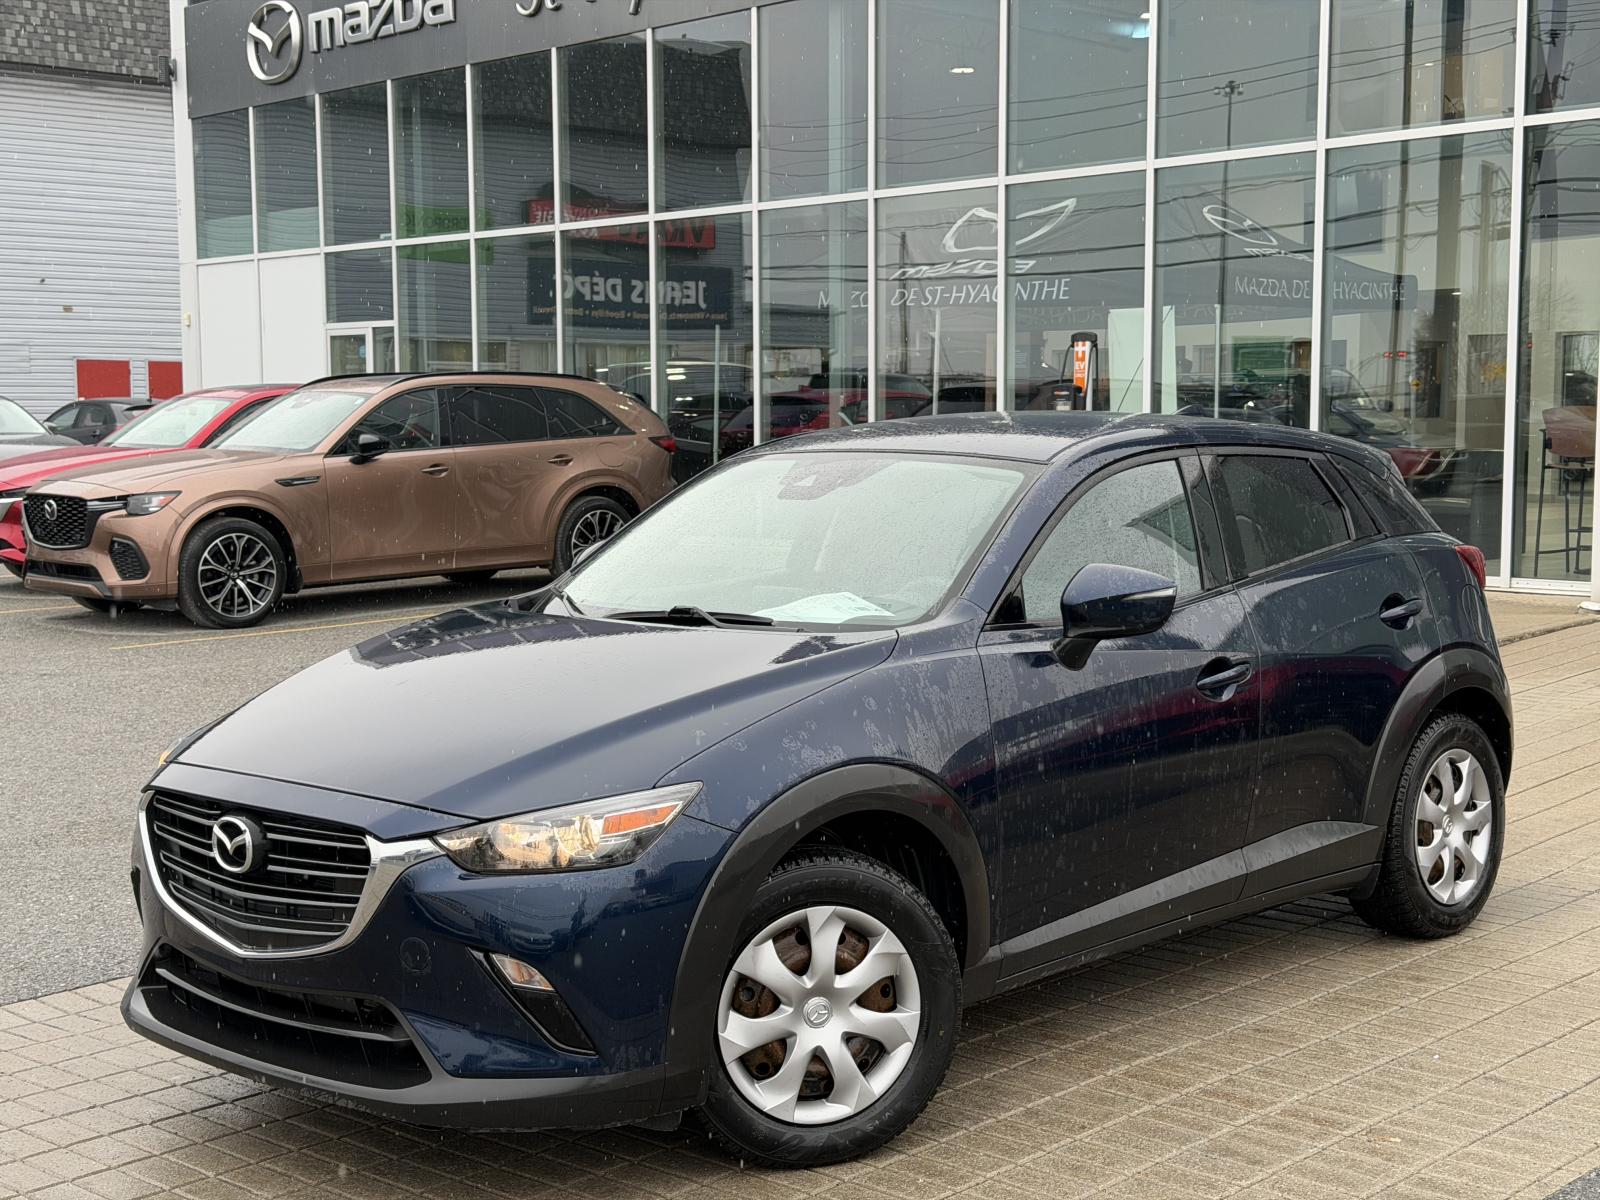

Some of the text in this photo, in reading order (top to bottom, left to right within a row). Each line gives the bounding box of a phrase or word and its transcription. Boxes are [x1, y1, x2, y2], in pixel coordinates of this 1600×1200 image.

[890, 287, 919, 306] DE
[920, 278, 1071, 306] ST-HYACNTHE
[1234, 276, 1407, 301] MAZDA DE HYACINTHE
